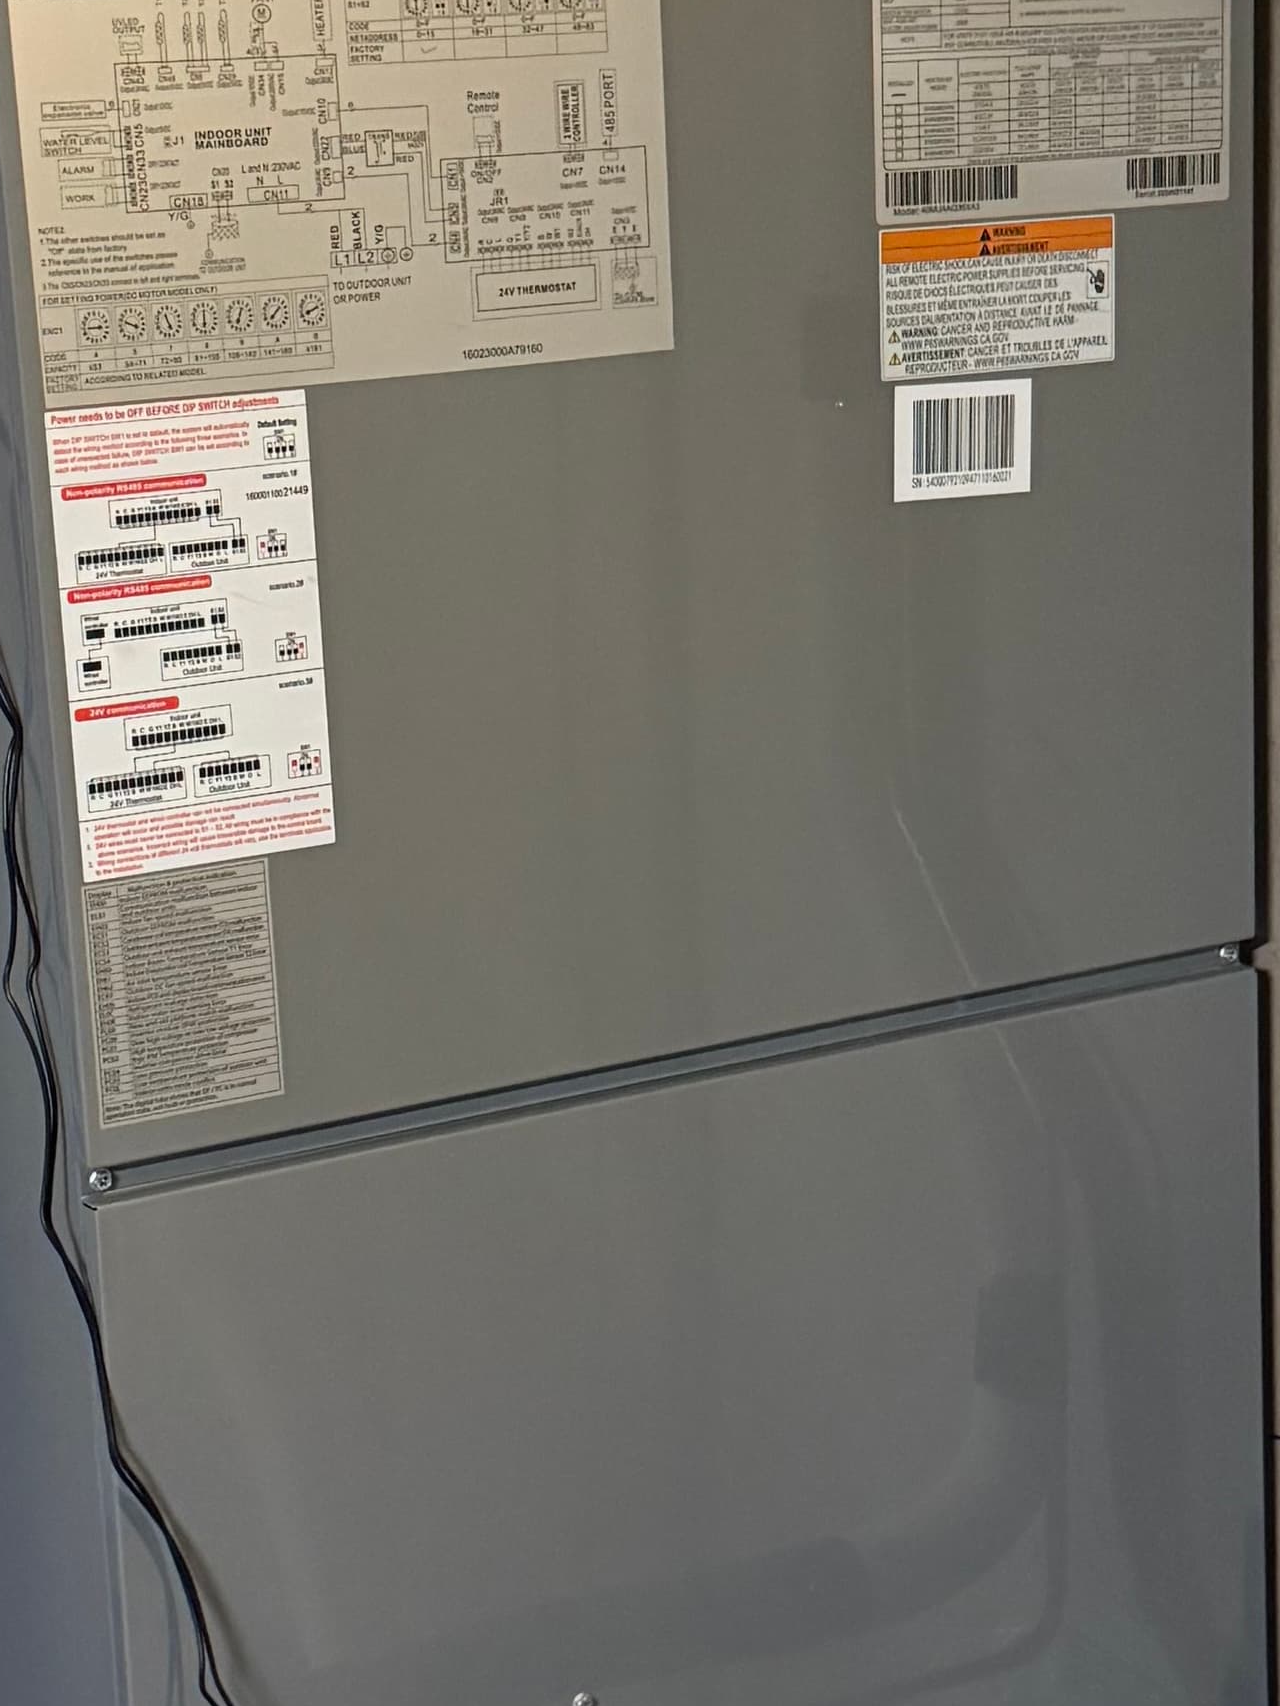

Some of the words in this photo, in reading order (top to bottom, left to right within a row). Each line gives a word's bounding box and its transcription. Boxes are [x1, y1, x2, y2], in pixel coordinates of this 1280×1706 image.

[466, 91, 500, 100] Remote
[602, 73, 614, 110] PORT
[467, 103, 499, 113] Control
[571, 86, 581, 141] CONTROLLER
[604, 111, 616, 132] 485
[194, 129, 242, 141] INDOOR
[244, 127, 272, 137] UNIT
[43, 138, 77, 147] WATER
[79, 136, 110, 145] LEVEL
[195, 138, 269, 149] MAINBOARD
[43, 147, 82, 155] SWITCH
[62, 166, 95, 175] ALARM
[562, 167, 584, 177] CN7
[599, 164, 626, 174] CN14
[330, 225, 340, 249] RED
[352, 211, 362, 250] BLACK
[993, 226, 1026, 237] WARNING
[335, 254, 350, 266] L1
[357, 252, 375, 264] L2
[886, 264, 901, 274] RISK
[902, 263, 911, 273] OF
[911, 261, 943, 273] ELECTRIC
[981, 257, 1004, 268] CAUSE
[886, 276, 898, 287] ALL
[899, 275, 927, 286] REMOTE
[929, 271, 962, 284] ELECTRIC
[962, 269, 988, 281] POWER
[1021, 265, 1048, 278] BEFORE
[1049, 263, 1085, 274] SERVICING
[333, 282, 346, 290] TO
[347, 278, 391, 290] OUTDOOR
[391, 276, 411, 287] UNIT
[499, 287, 515, 297] 24V
[517, 282, 576, 294] THERMOSTAT
[334, 295, 347, 304] OR
[348, 292, 380, 302] POWER
[940, 324, 972, 336] CANCER
[974, 322, 990, 333] AND
[992, 318, 1050, 331] REPRODUCTIVE
[967, 346, 999, 357] CANCER
[1001, 344, 1011, 354] ET
[1013, 341, 1052, 353] TROUBLES
[51, 415, 77, 425] Power
[79, 413, 103, 422] needs
[105, 412, 114, 420] to
[115, 411, 125, 420] be
[127, 407, 144, 418] OFF
[145, 404, 180, 416] BEFORE
[183, 403, 197, 414] DIP
[198, 400, 231, 412] SWITCH
[232, 396, 279, 411] adjustments
[257, 420, 277, 428] Default
[144, 477, 205, 490] communication
[123, 585, 149, 595] RS485
[151, 578, 210, 592] communication
[89, 709, 105, 717] 24V
[106, 701, 167, 715] communication
